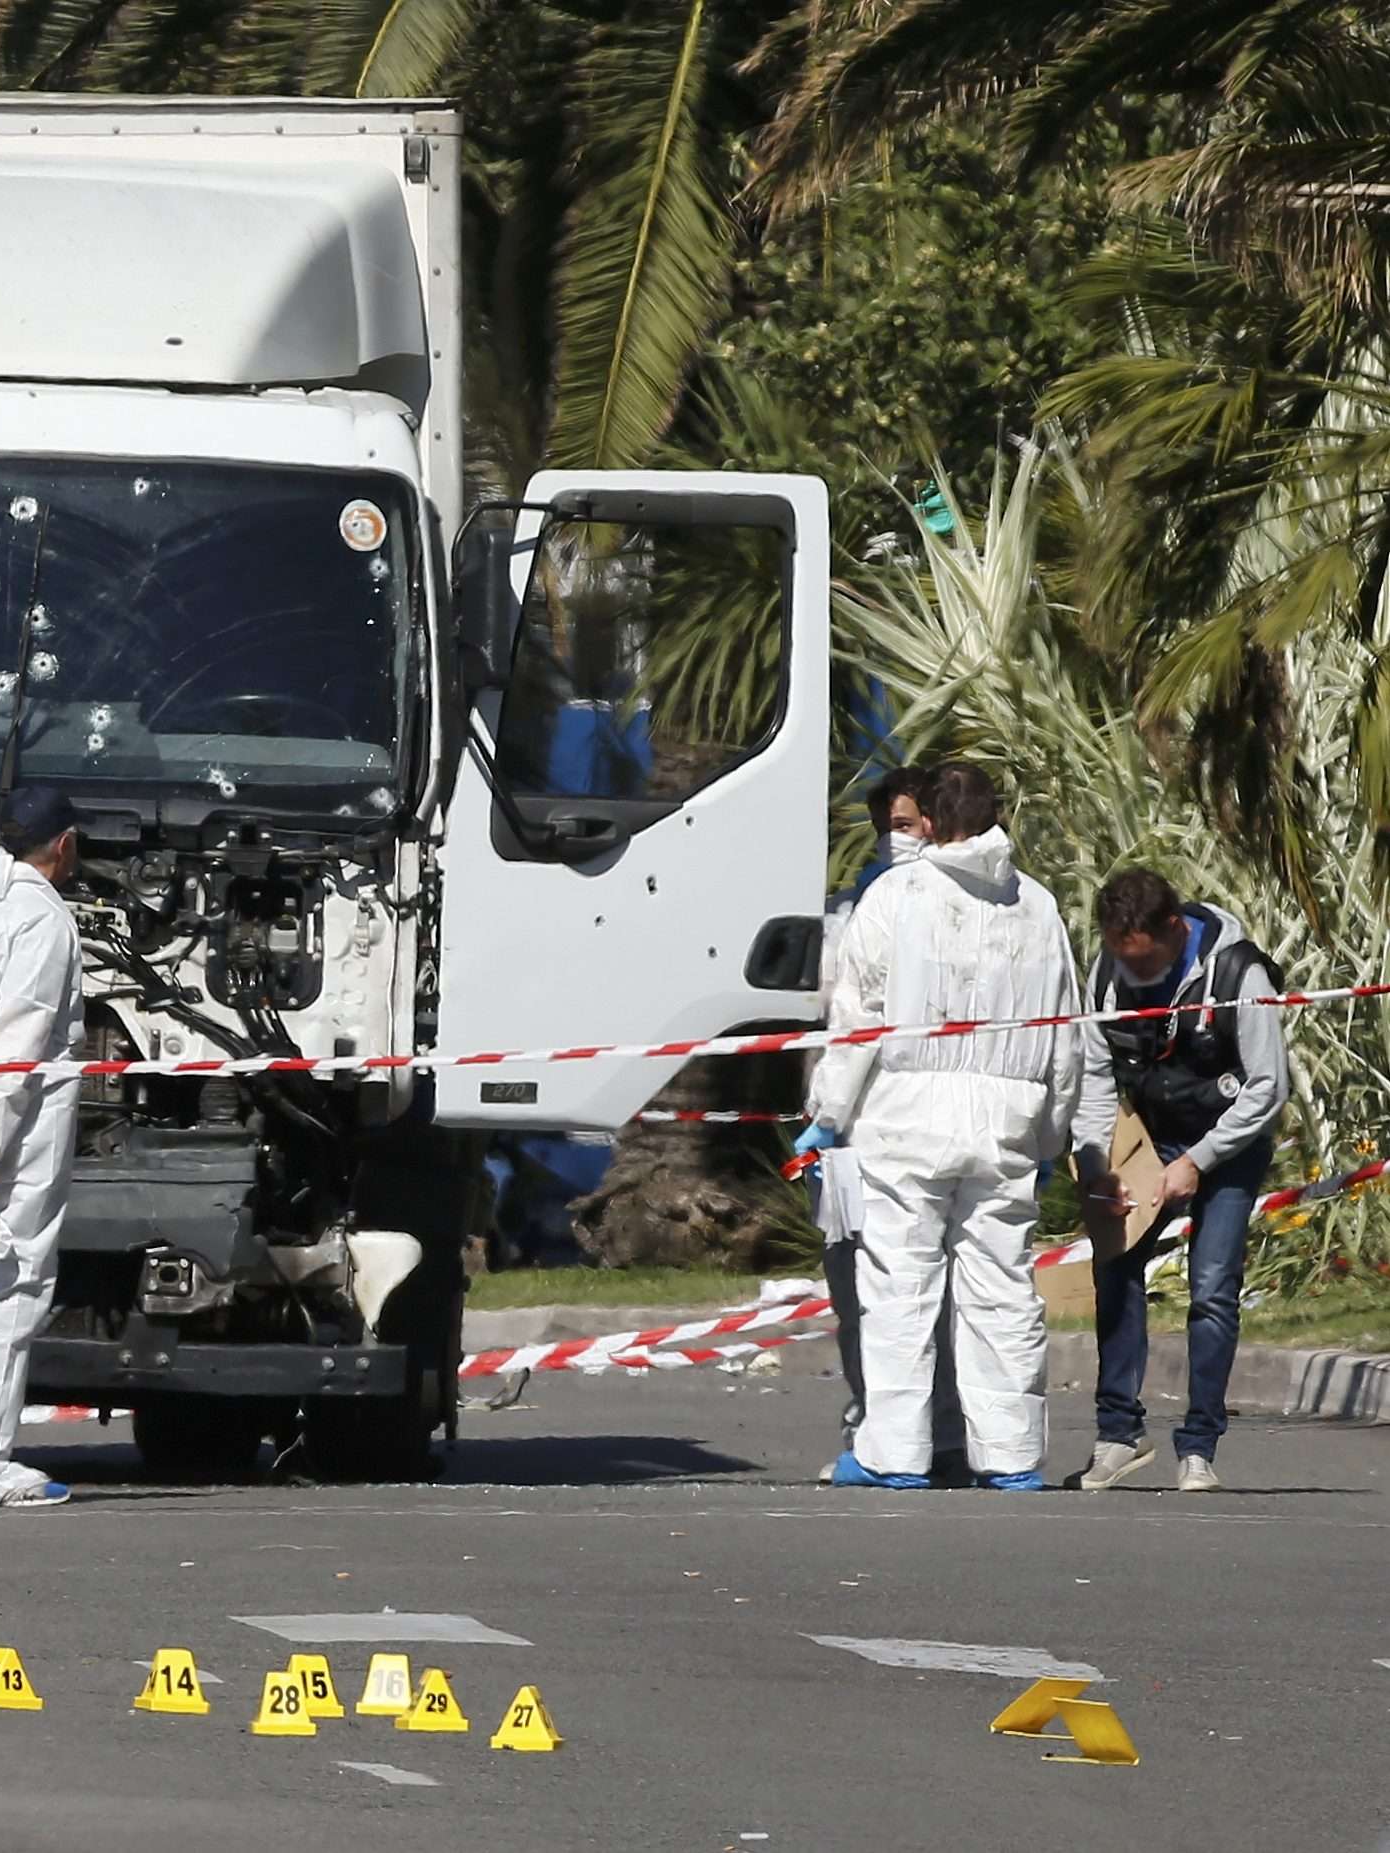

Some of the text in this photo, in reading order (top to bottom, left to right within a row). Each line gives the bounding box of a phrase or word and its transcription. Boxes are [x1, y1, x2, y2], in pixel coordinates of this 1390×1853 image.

[2, 1669, 23, 1691] 13
[161, 1665, 194, 1696] 14
[372, 1669, 405, 1698] 16
[270, 1685, 300, 1715] 28
[426, 1693, 448, 1713] 29
[513, 1704, 534, 1728] 27
